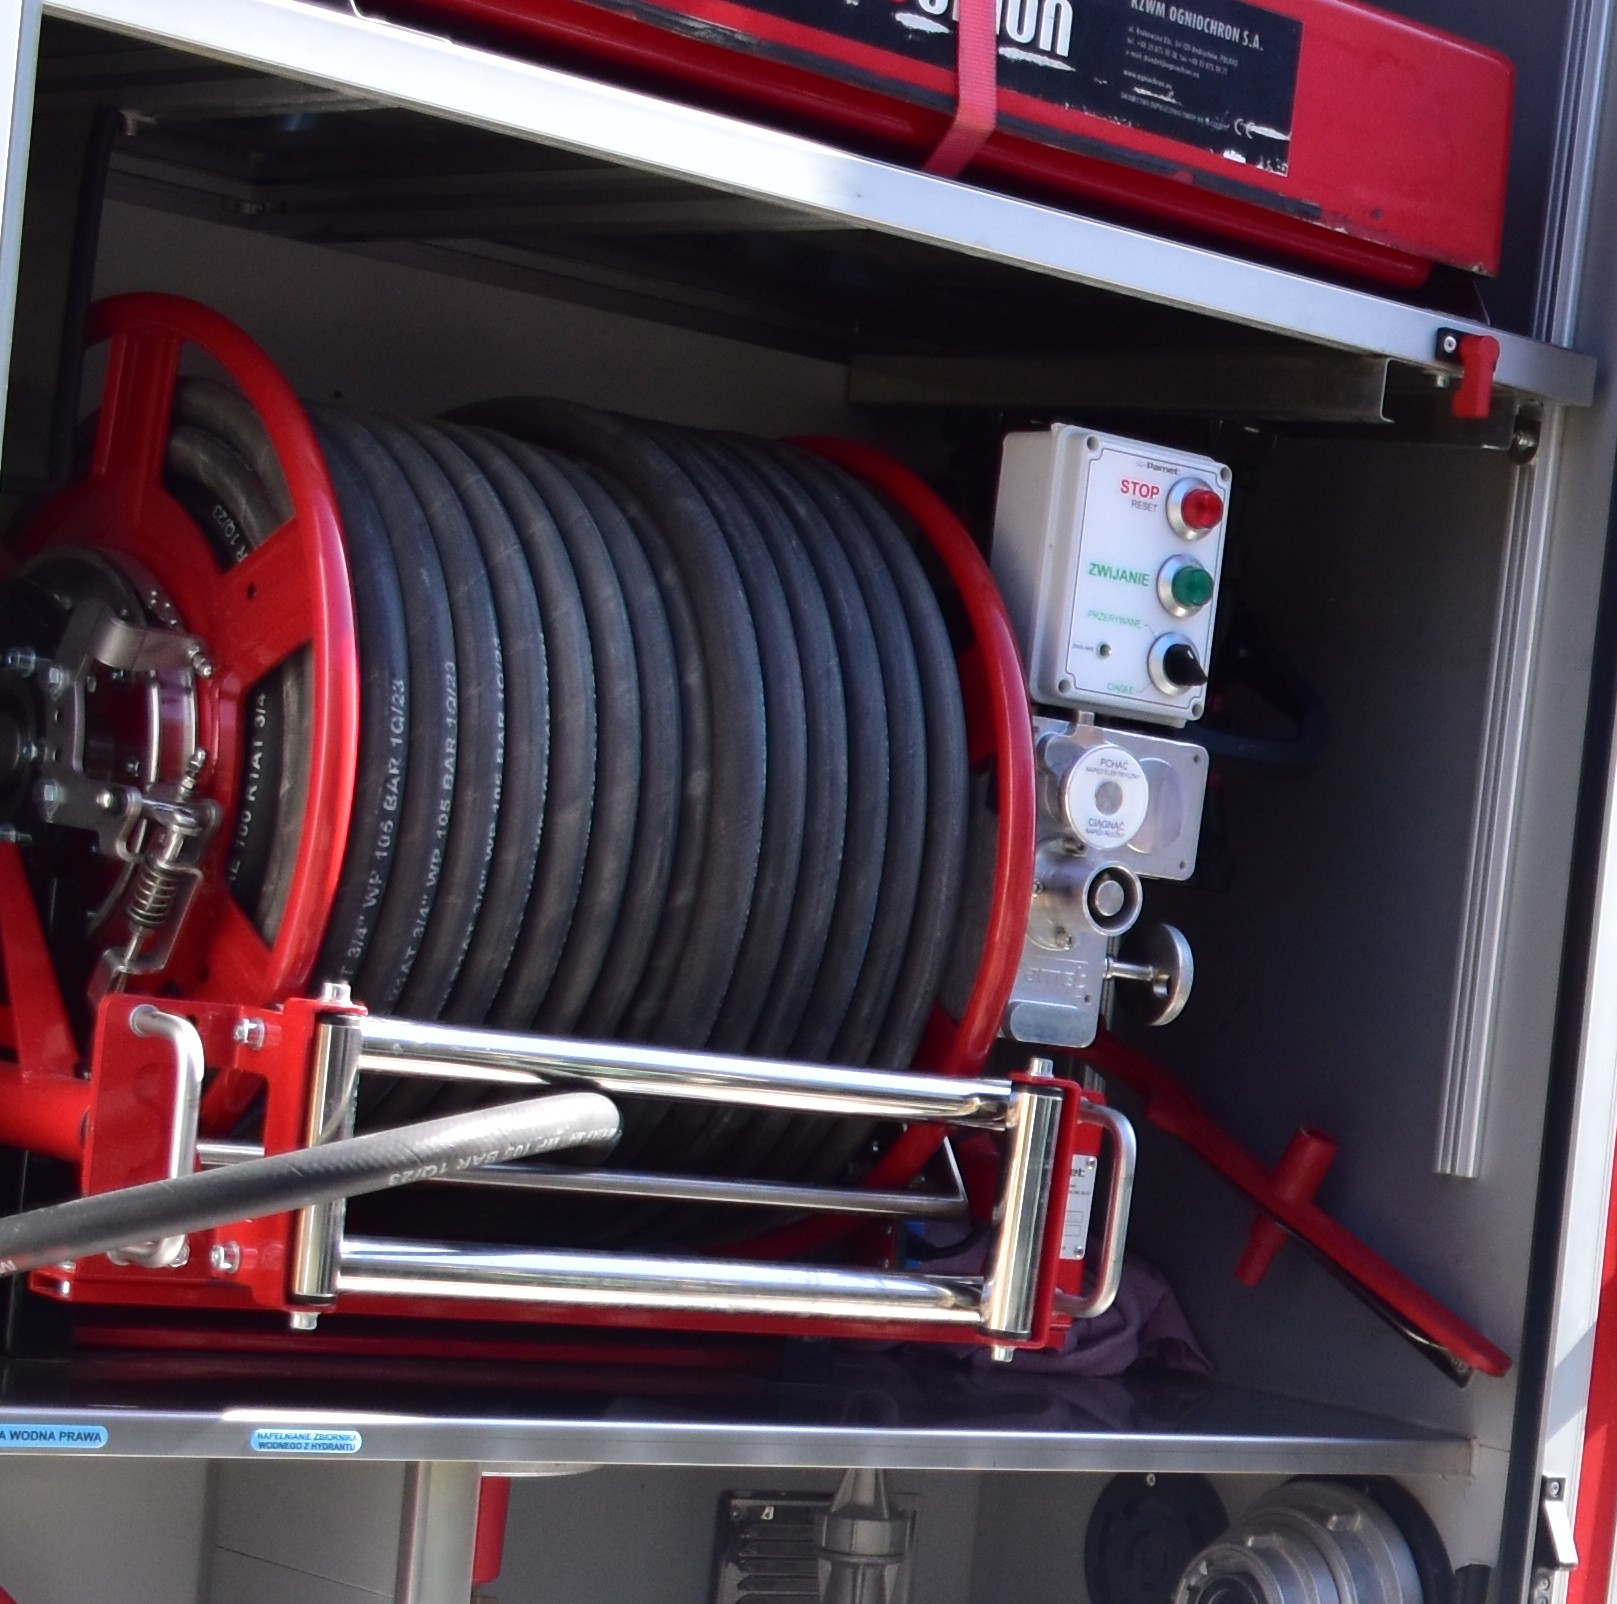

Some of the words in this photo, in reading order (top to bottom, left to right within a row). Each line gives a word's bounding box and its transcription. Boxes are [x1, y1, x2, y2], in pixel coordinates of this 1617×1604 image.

[1169, 5, 1240, 43] OGNIOCHRON
[1243, 28, 1264, 52] S.A.
[1120, 479, 1160, 499] STOP
[1131, 500, 1158, 512] RESET
[1088, 562, 1150, 587] ZWIJANIE
[1087, 609, 1142, 628] PRZERYWANE
[442, 738, 457, 791] BAR
[1100, 757, 1129, 770] PCHAĆ
[382, 757, 401, 811] BAR
[435, 798, 451, 839] 105
[1088, 818, 1125, 832] CIĄGNĄĆ
[425, 848, 443, 887] WP
[456, 1150, 500, 1170] BAR
[10, 1430, 56, 1441] WODNA
[59, 1431, 102, 1442] PRAWA
[258, 1441, 303, 1450] WODNEGO
[303, 1442, 310, 1450] Z
[311, 1443, 356, 1451] HYDRANTU
